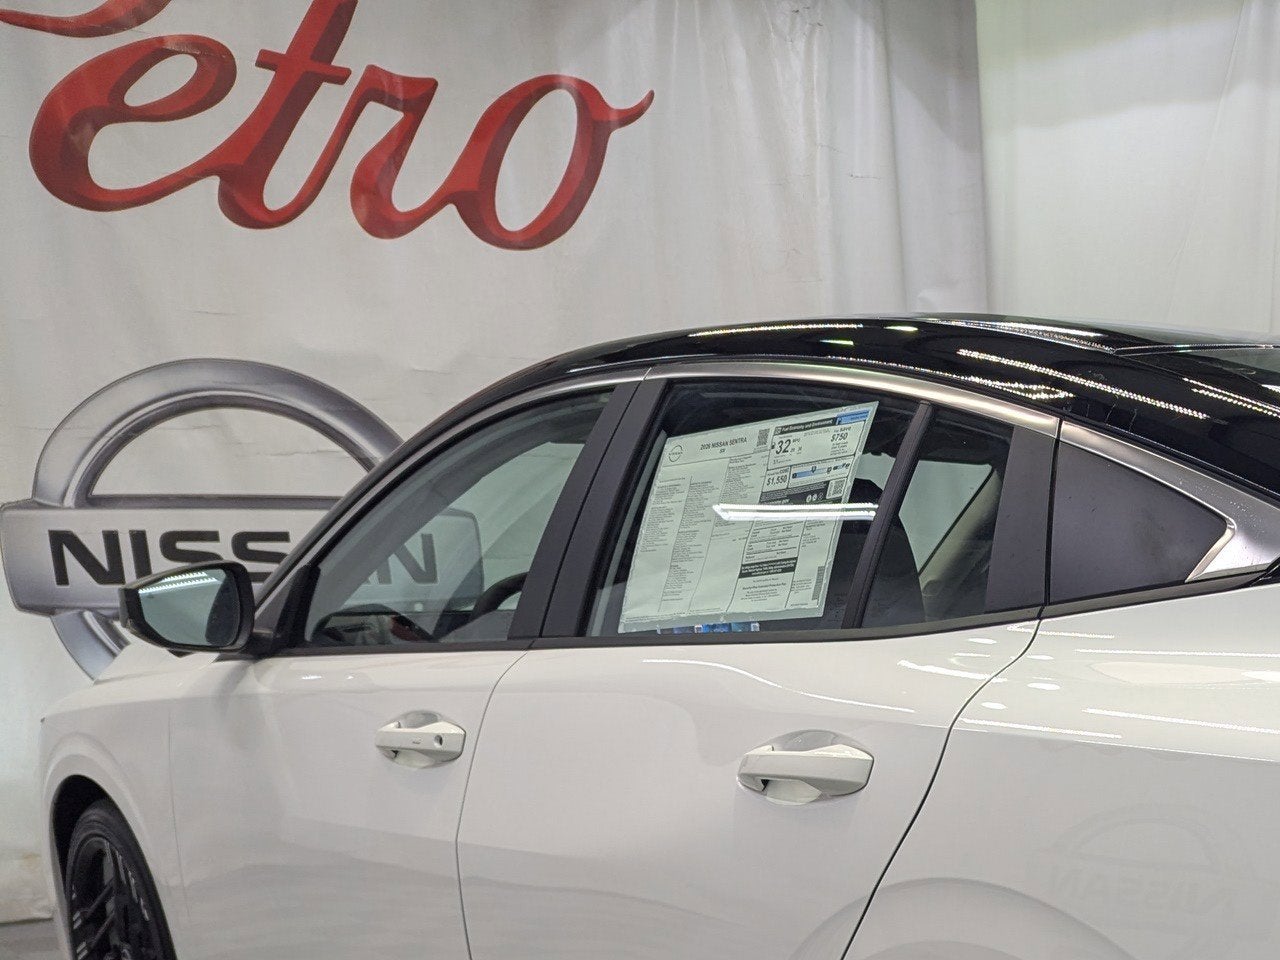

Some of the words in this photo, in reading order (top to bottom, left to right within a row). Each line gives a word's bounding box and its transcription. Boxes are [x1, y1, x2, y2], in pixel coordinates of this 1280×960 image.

[0, 0, 654, 251] etro
[775, 439, 791, 455] 32
[830, 432, 849, 442] $750
[47, 528, 441, 586] NISSN
